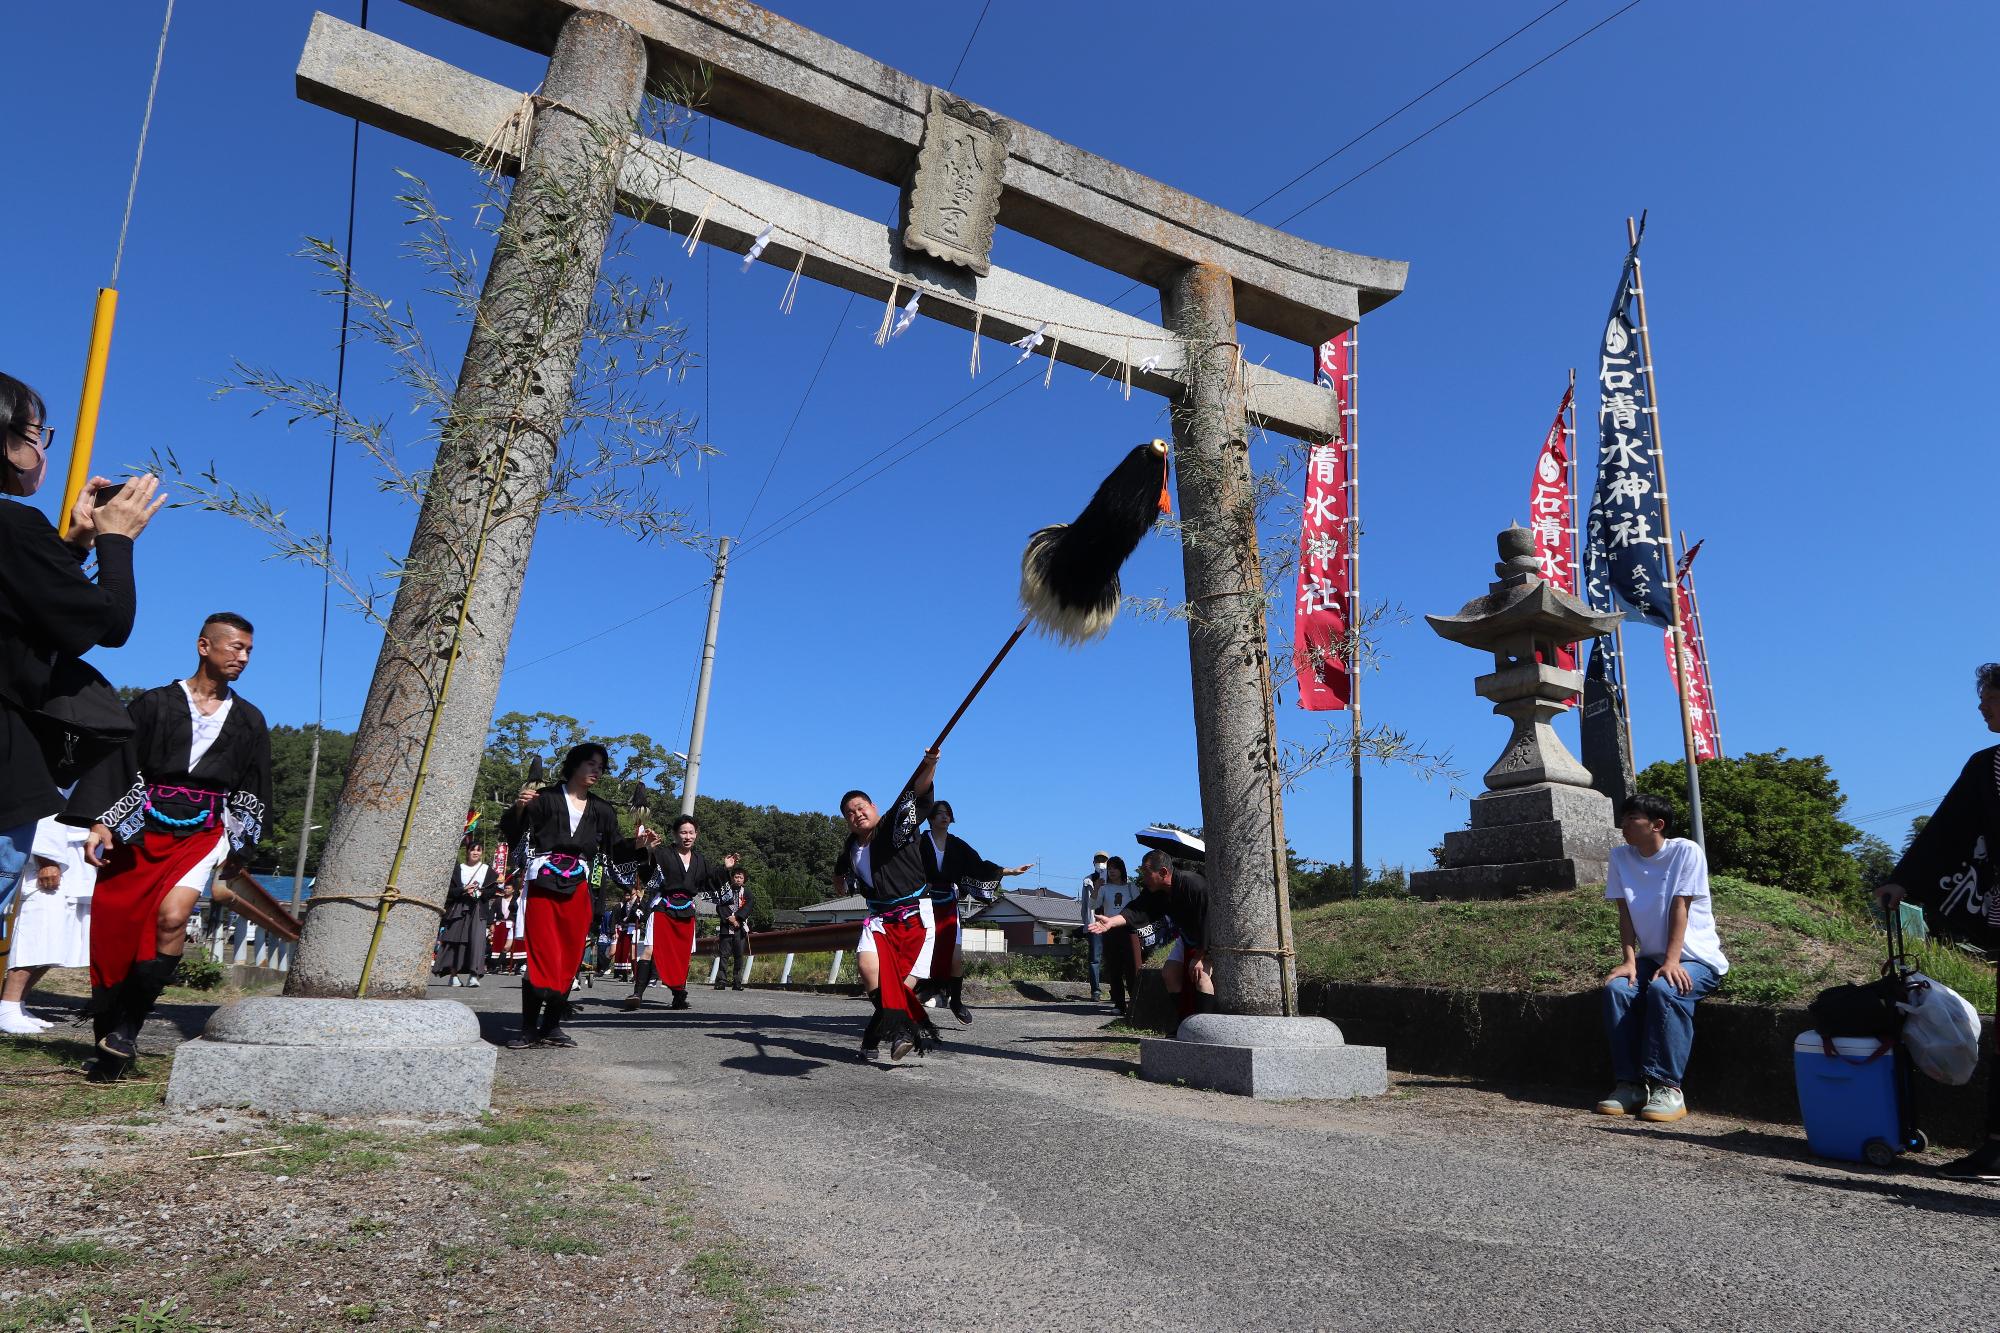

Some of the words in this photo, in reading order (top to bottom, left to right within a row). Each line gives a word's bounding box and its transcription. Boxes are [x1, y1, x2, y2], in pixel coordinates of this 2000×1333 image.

[1599, 355, 1657, 548] 石清水神社
